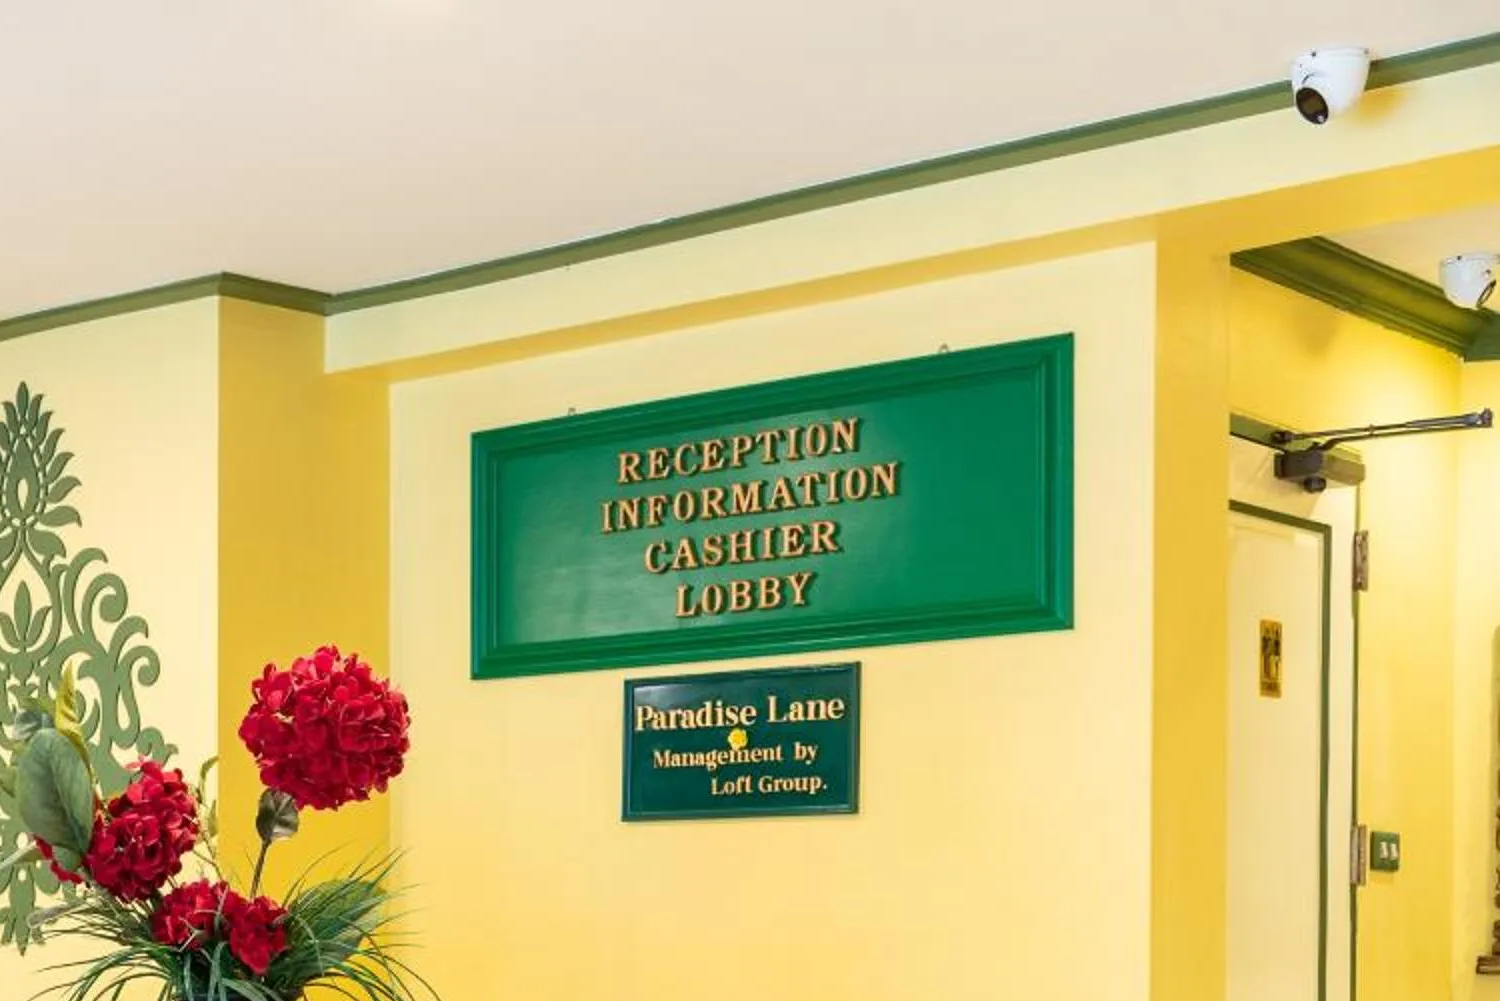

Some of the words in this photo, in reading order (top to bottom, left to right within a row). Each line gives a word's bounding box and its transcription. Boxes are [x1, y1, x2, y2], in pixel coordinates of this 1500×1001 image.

[618, 416, 859, 484] RECEPTION
[601, 462, 899, 533] INFORMATION
[645, 520, 841, 574] CASHIER
[675, 571, 814, 618] LOBBY
[635, 700, 757, 731] Paradise
[767, 696, 845, 723] Lane
[653, 745, 784, 771] Management
[794, 742, 818, 765] by
[711, 776, 752, 796] Loft
[758, 775, 828, 795] Group.
